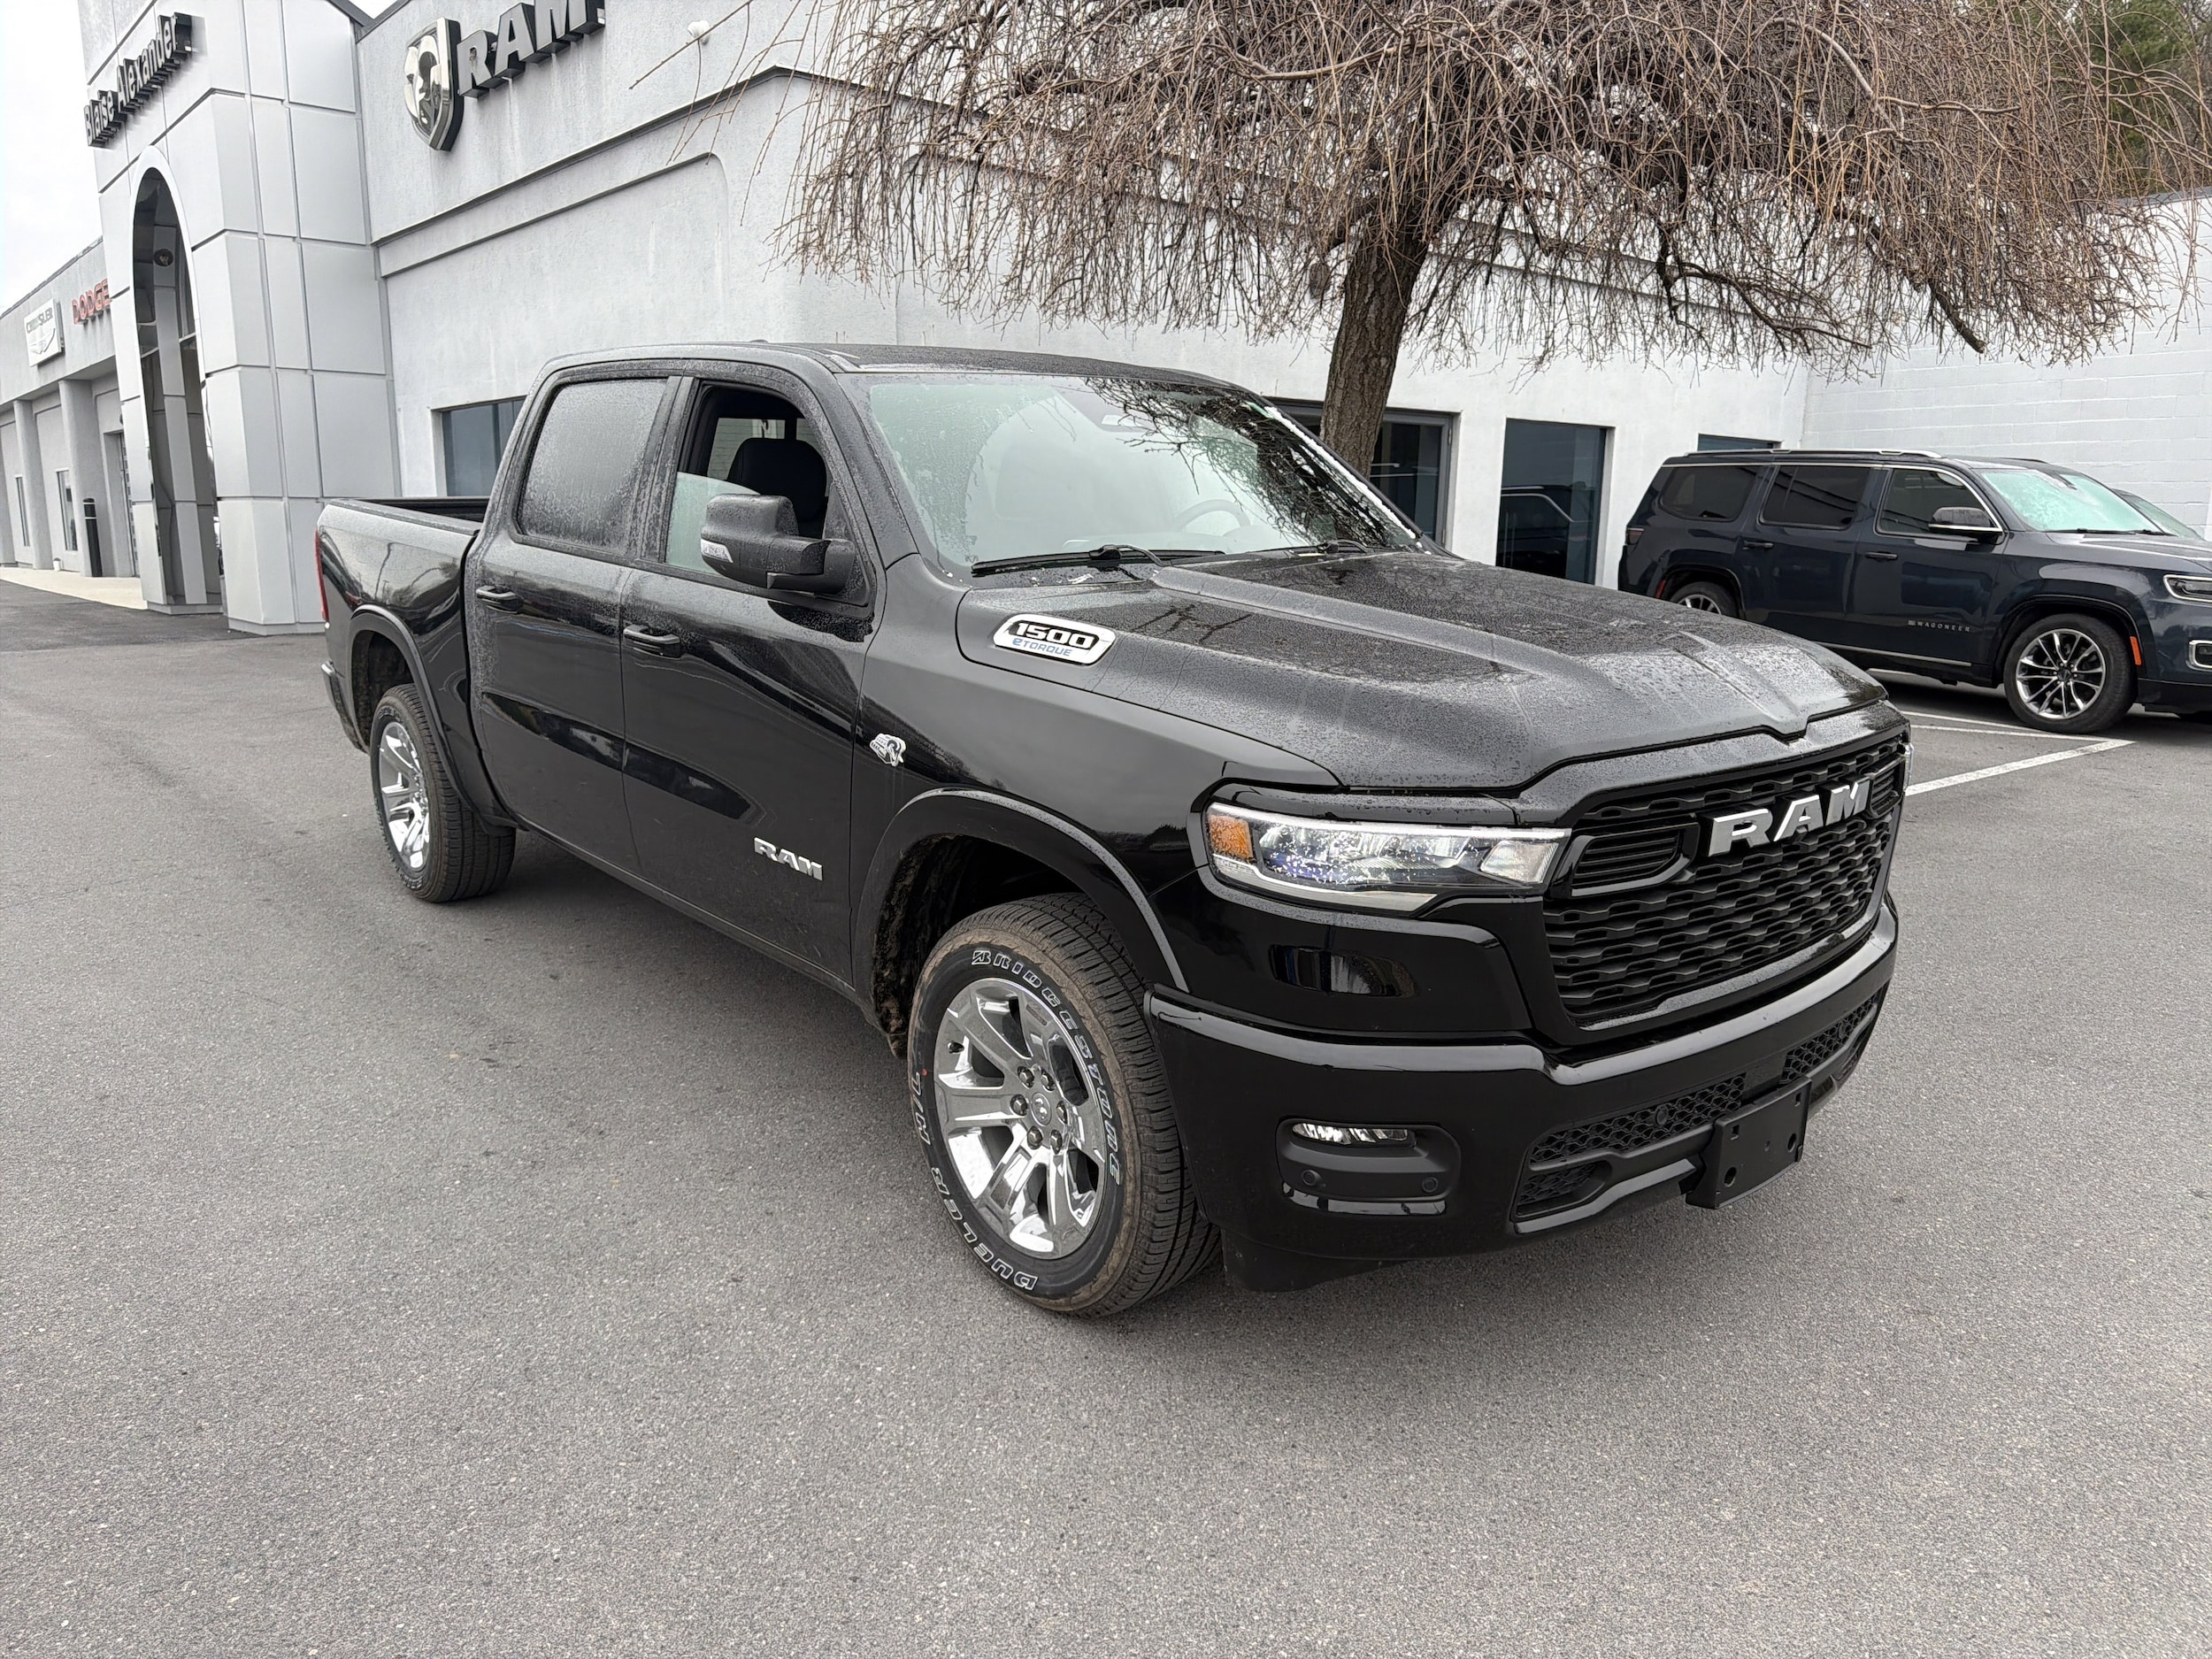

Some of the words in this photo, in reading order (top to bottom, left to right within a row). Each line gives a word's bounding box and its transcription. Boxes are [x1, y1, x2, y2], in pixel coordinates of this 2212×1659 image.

[457, 0, 588, 96] RAM
[84, 90, 115, 146] Blaise
[117, 13, 178, 113] Alexander
[27, 307, 53, 334] CSLER
[72, 278, 111, 325] DODGE
[1012, 638, 1072, 657] eTORQUE
[1017, 622, 1095, 649] 1500
[1917, 621, 1970, 632] WAGONEER
[1709, 779, 1870, 856] RAM
[754, 837, 823, 881] RAM
[972, 950, 1120, 1185] BRIDGESTONE
[911, 1072, 931, 1145] H/L
[931, 1167, 1038, 1290] DUELER
